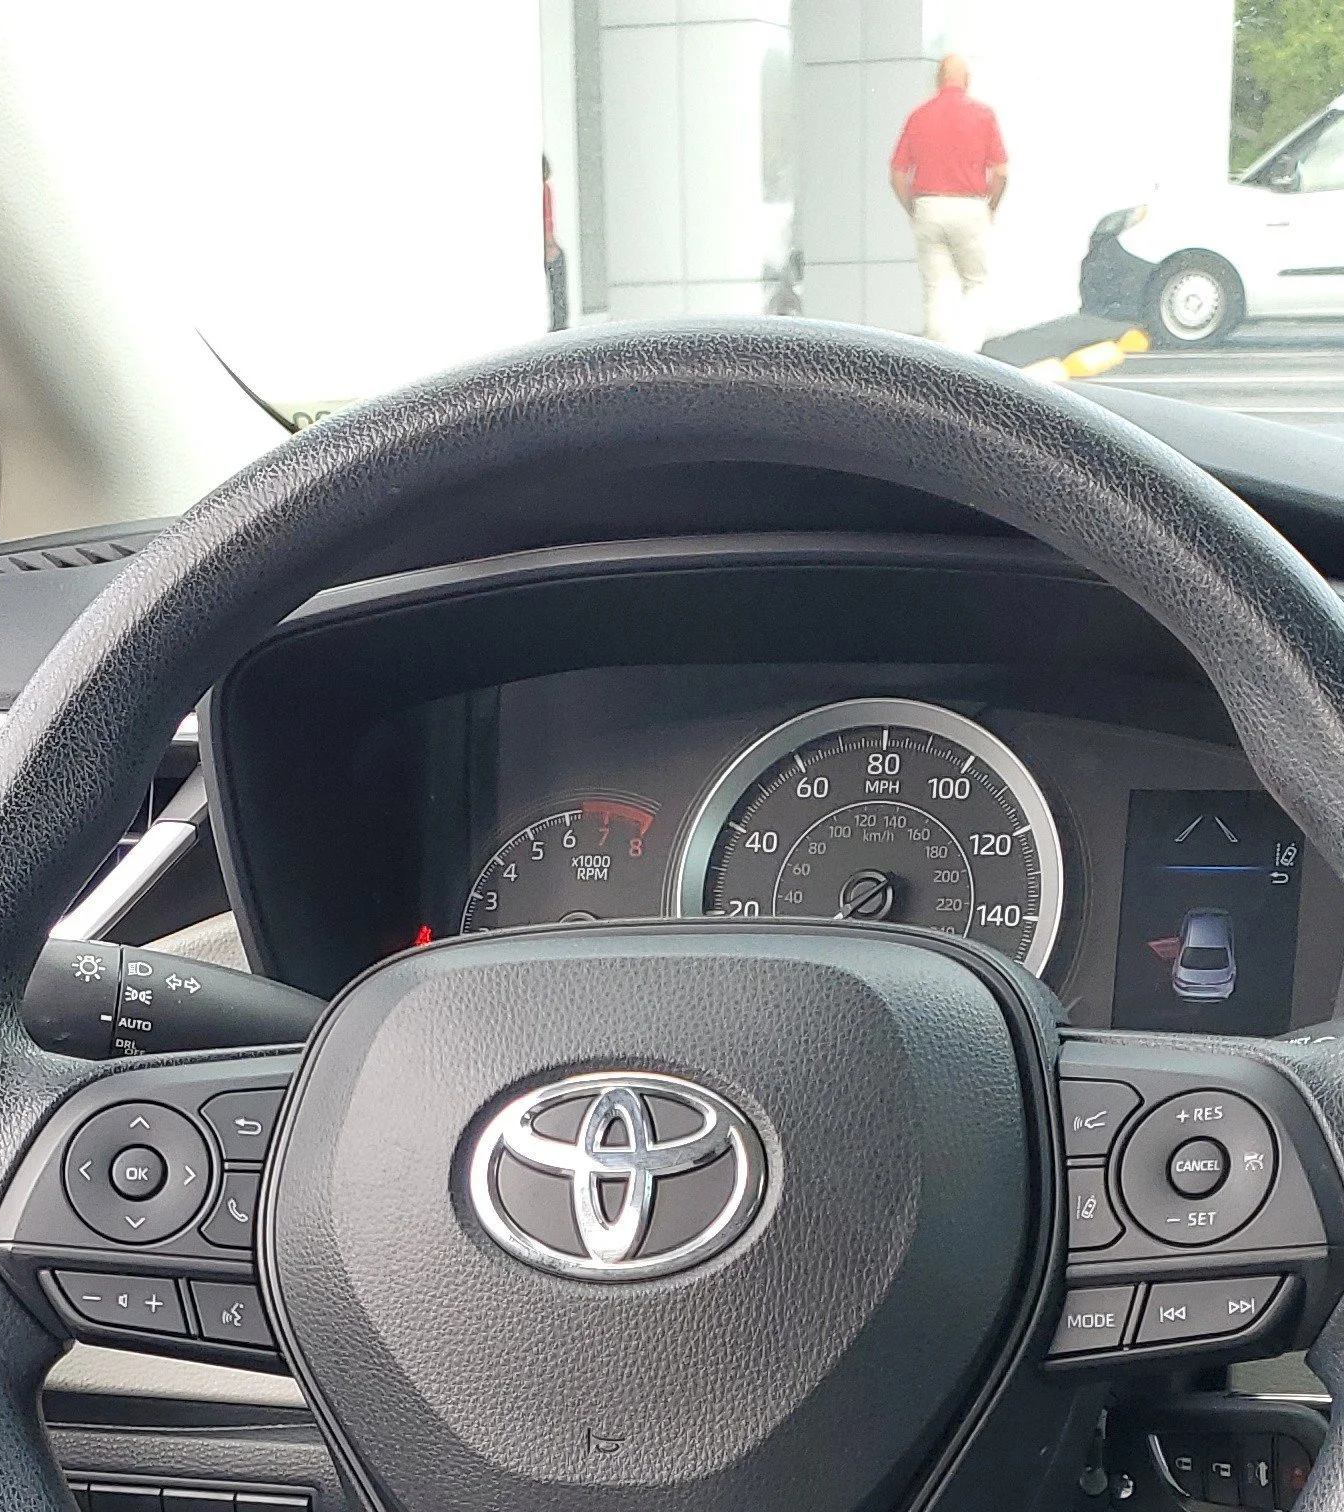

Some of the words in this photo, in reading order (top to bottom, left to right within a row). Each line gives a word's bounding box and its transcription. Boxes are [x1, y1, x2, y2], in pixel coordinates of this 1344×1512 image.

[867, 753, 901, 776] 80
[796, 777, 829, 798] 60
[865, 780, 900, 795] MPH
[927, 778, 971, 799] 100
[854, 814, 876, 828] 120
[884, 815, 907, 829] 140
[562, 830, 577, 849] 6
[598, 827, 610, 846] 7
[829, 825, 851, 839] 100
[862, 828, 895, 844] km/h
[907, 828, 930, 842] 160
[531, 841, 544, 860] 5
[629, 838, 643, 857] 8
[745, 832, 778, 853] 40
[808, 842, 826, 856] 80
[969, 834, 1012, 856] 120
[925, 845, 948, 859] 180
[503, 862, 518, 882] 4
[577, 868, 608, 881] RPM
[792, 863, 811, 877] 60
[933, 870, 960, 884] 200
[485, 892, 498, 911] 3
[784, 891, 803, 904] 40
[936, 898, 963, 912] 220
[728, 901, 760, 917] 20
[976, 904, 1021, 927] 140
[118, 1017, 152, 1031] AUTO
[115, 1038, 137, 1049] DRL
[1175, 1157, 1221, 1174] CANCEL
[125, 1166, 149, 1182] OK
[1067, 1311, 1116, 1330] MODE
